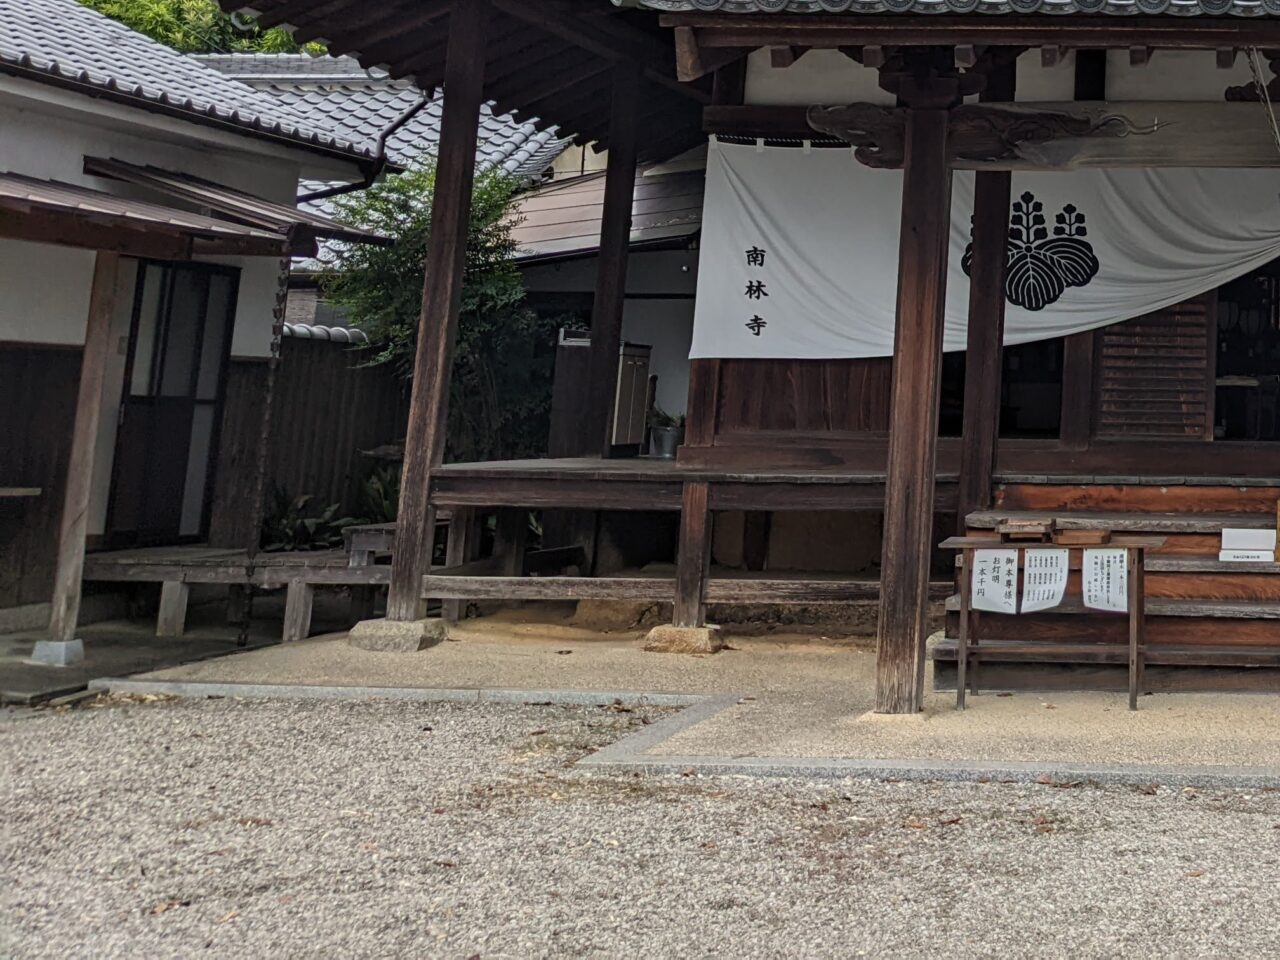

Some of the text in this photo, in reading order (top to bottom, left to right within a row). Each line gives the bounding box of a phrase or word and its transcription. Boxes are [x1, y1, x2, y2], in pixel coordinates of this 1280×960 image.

[744, 245, 769, 337] 南林寺
[977, 560, 988, 597] 一本千円
[991, 556, 1001, 584] お灯明
[1003, 557, 1014, 606] 御本尊様へ
